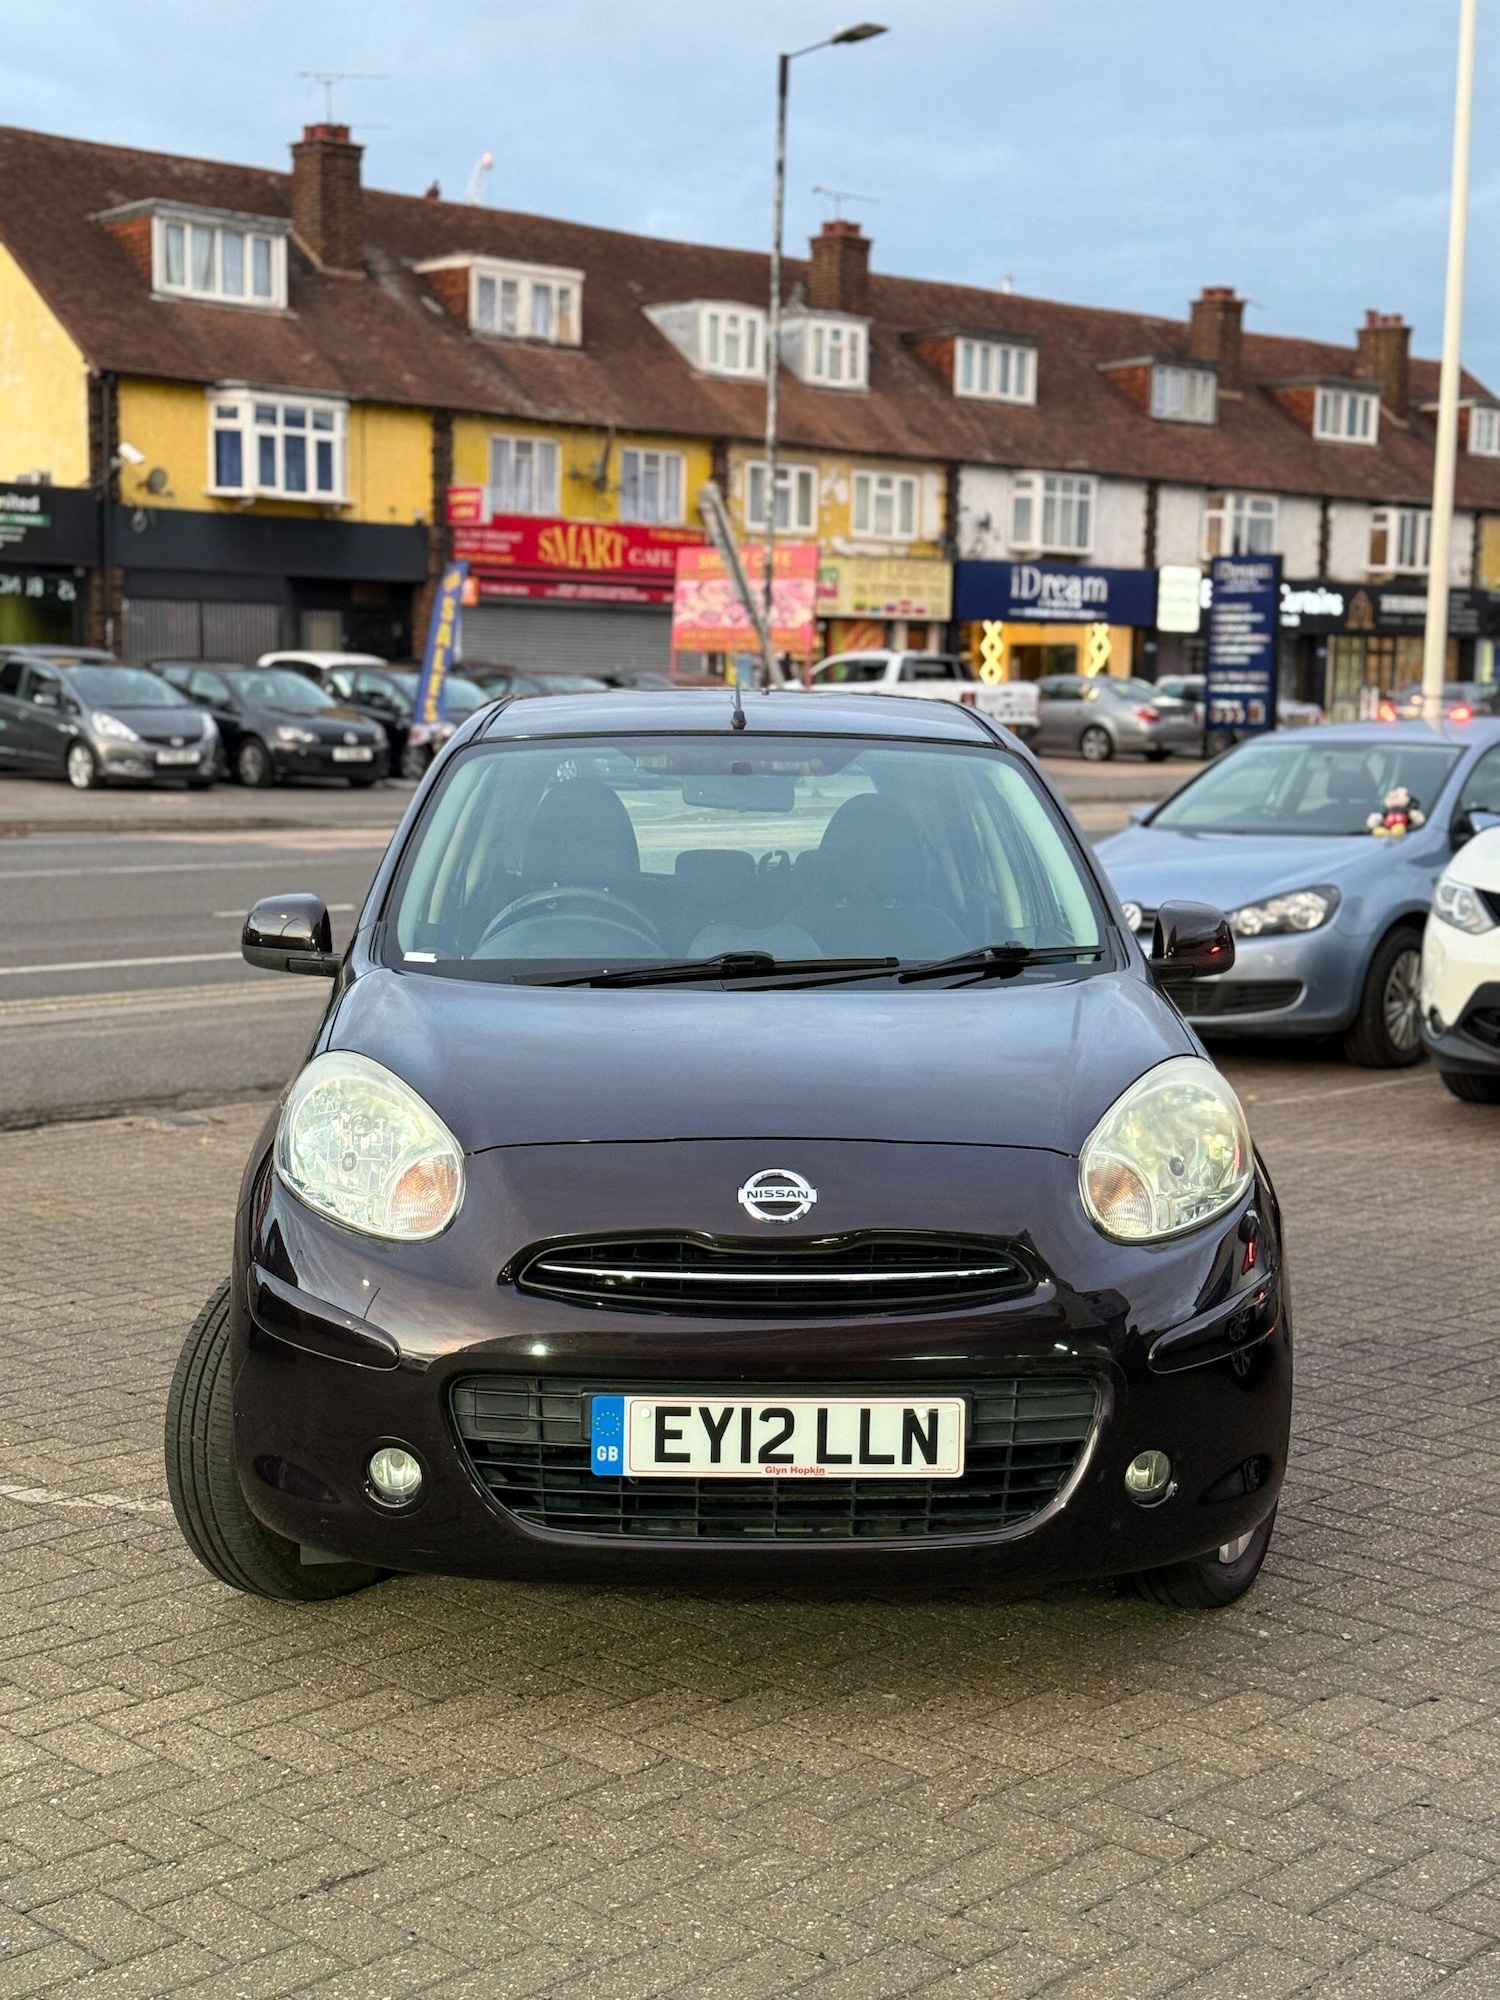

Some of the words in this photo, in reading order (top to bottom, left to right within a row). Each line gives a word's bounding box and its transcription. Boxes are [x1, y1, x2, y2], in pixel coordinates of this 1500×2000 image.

[538, 524, 628, 569] SMART
[628, 547, 676, 568] CAFE
[1010, 564, 1108, 603] iDream
[746, 1189, 809, 1199] NISSAN
[654, 1406, 795, 1464] EY12
[817, 1407, 939, 1465] LLN
[596, 1445, 619, 1462] GB
[765, 1466, 787, 1475] Glyn
[790, 1465, 826, 1475] Hopkin
